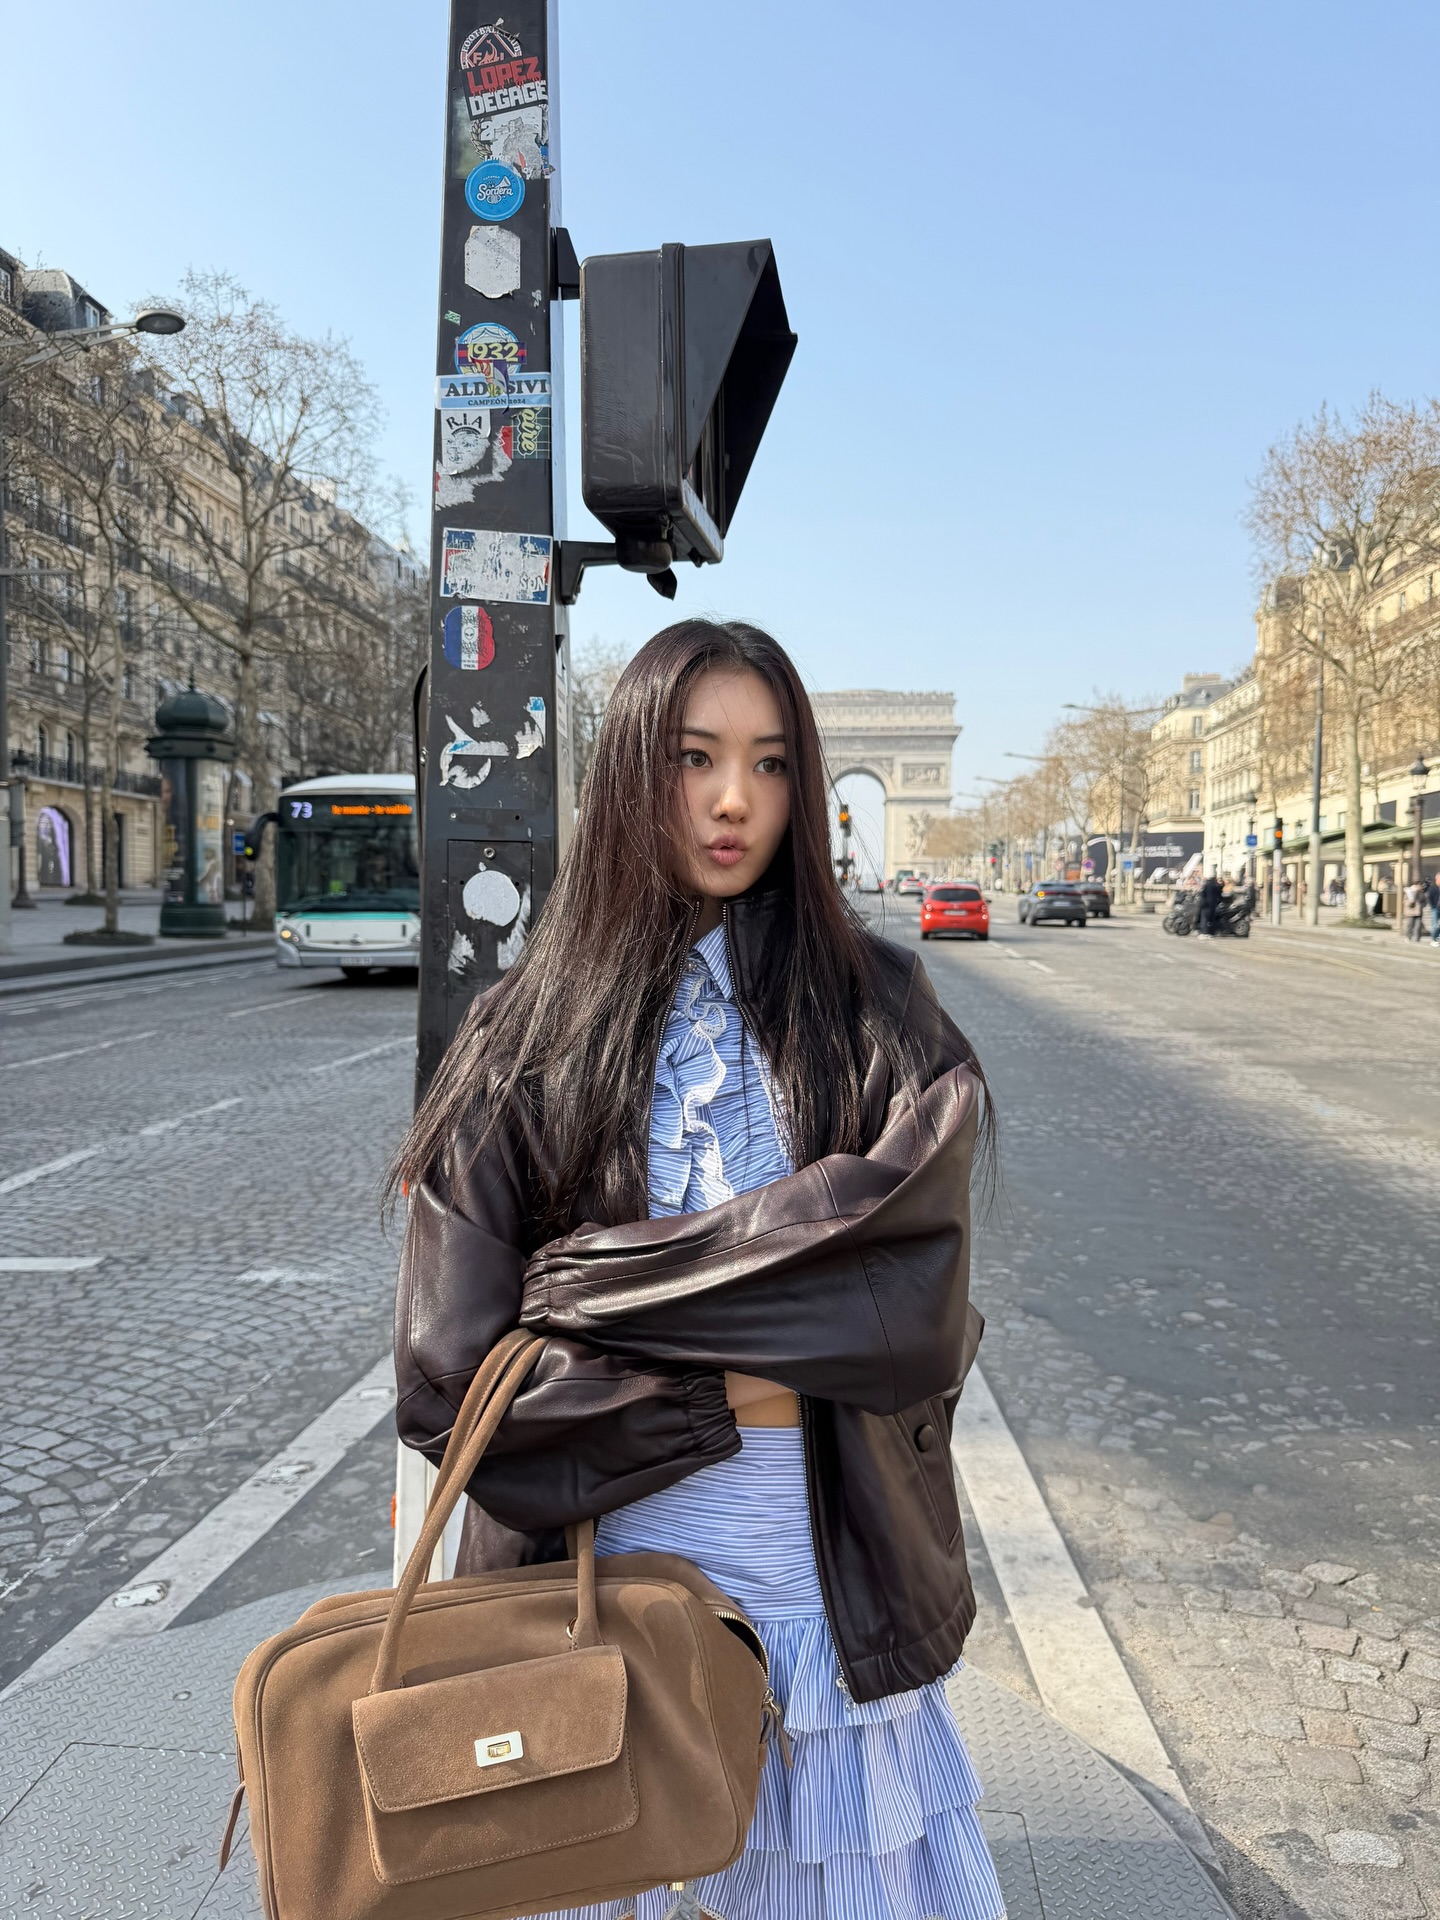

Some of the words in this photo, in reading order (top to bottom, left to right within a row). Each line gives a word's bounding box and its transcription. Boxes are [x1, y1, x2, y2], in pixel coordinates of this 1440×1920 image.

[461, 25, 502, 53] FOOTBAL
[467, 57, 542, 97] LOPEZ
[468, 80, 549, 116] DEGAGE
[467, 342, 519, 362] 1932
[445, 379, 549, 397] ALDSIVI
[468, 398, 507, 406] CAMPEÓN
[521, 407, 542, 452] oire
[290, 801, 313, 819] 73
